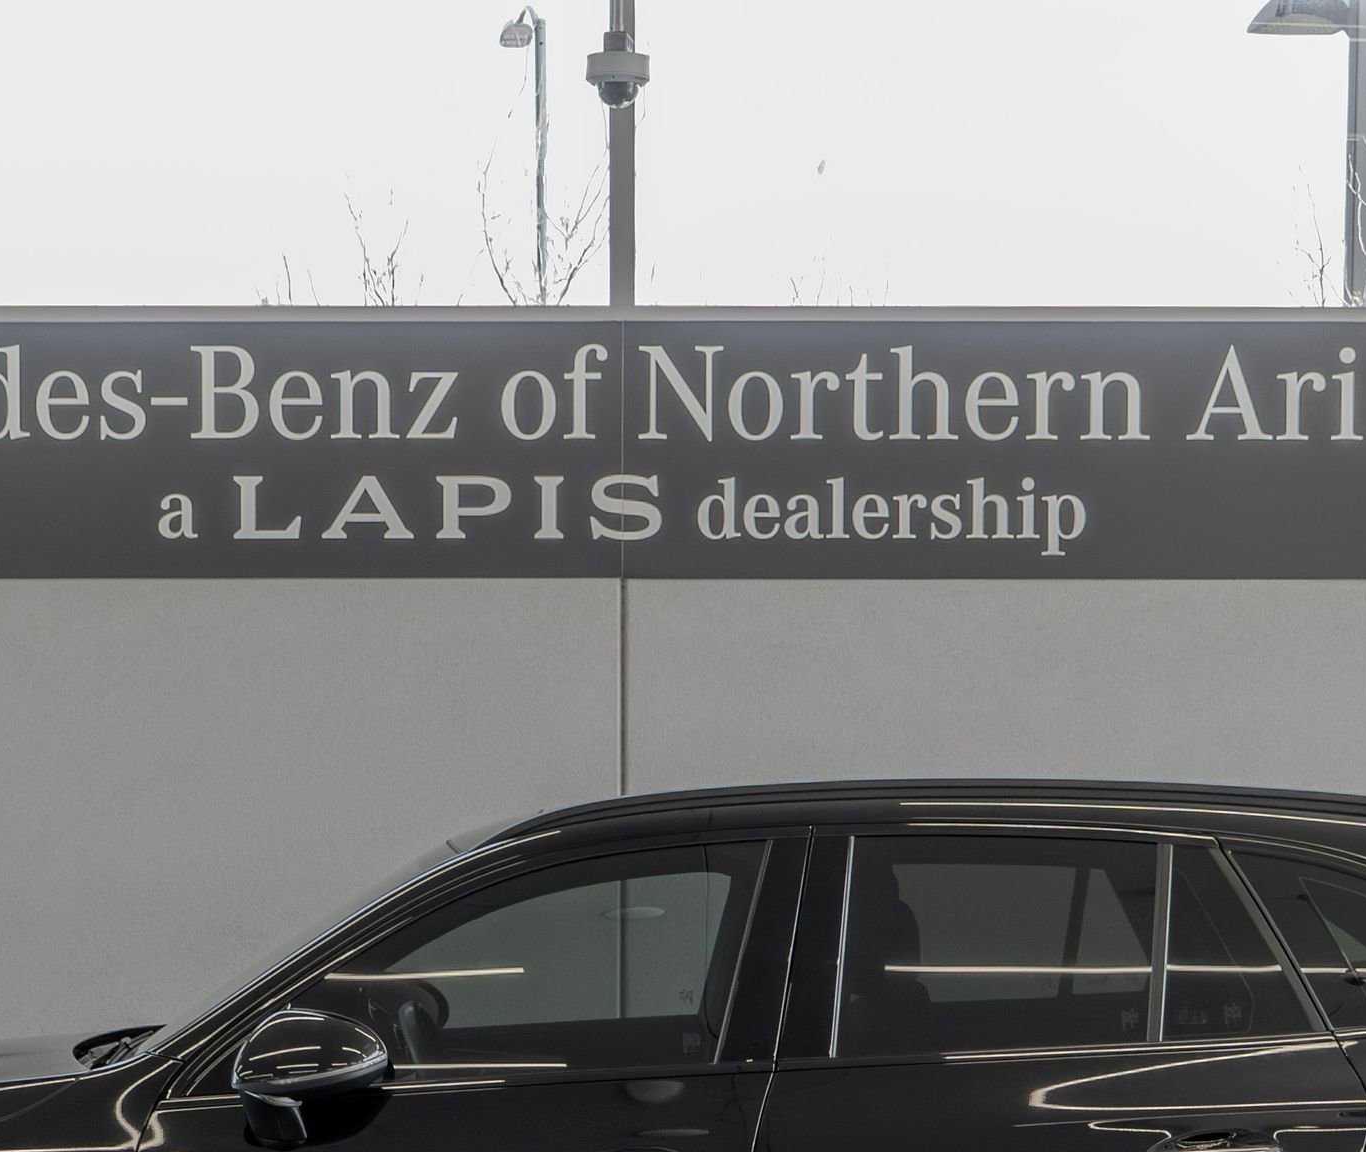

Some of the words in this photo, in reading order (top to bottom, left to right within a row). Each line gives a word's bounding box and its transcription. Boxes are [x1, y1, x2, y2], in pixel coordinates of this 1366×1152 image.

[501, 343, 609, 441] of
[638, 344, 1151, 443] Northern
[158, 493, 199, 540] a
[232, 474, 663, 541] LAPIS
[697, 476, 1087, 556] dealership
